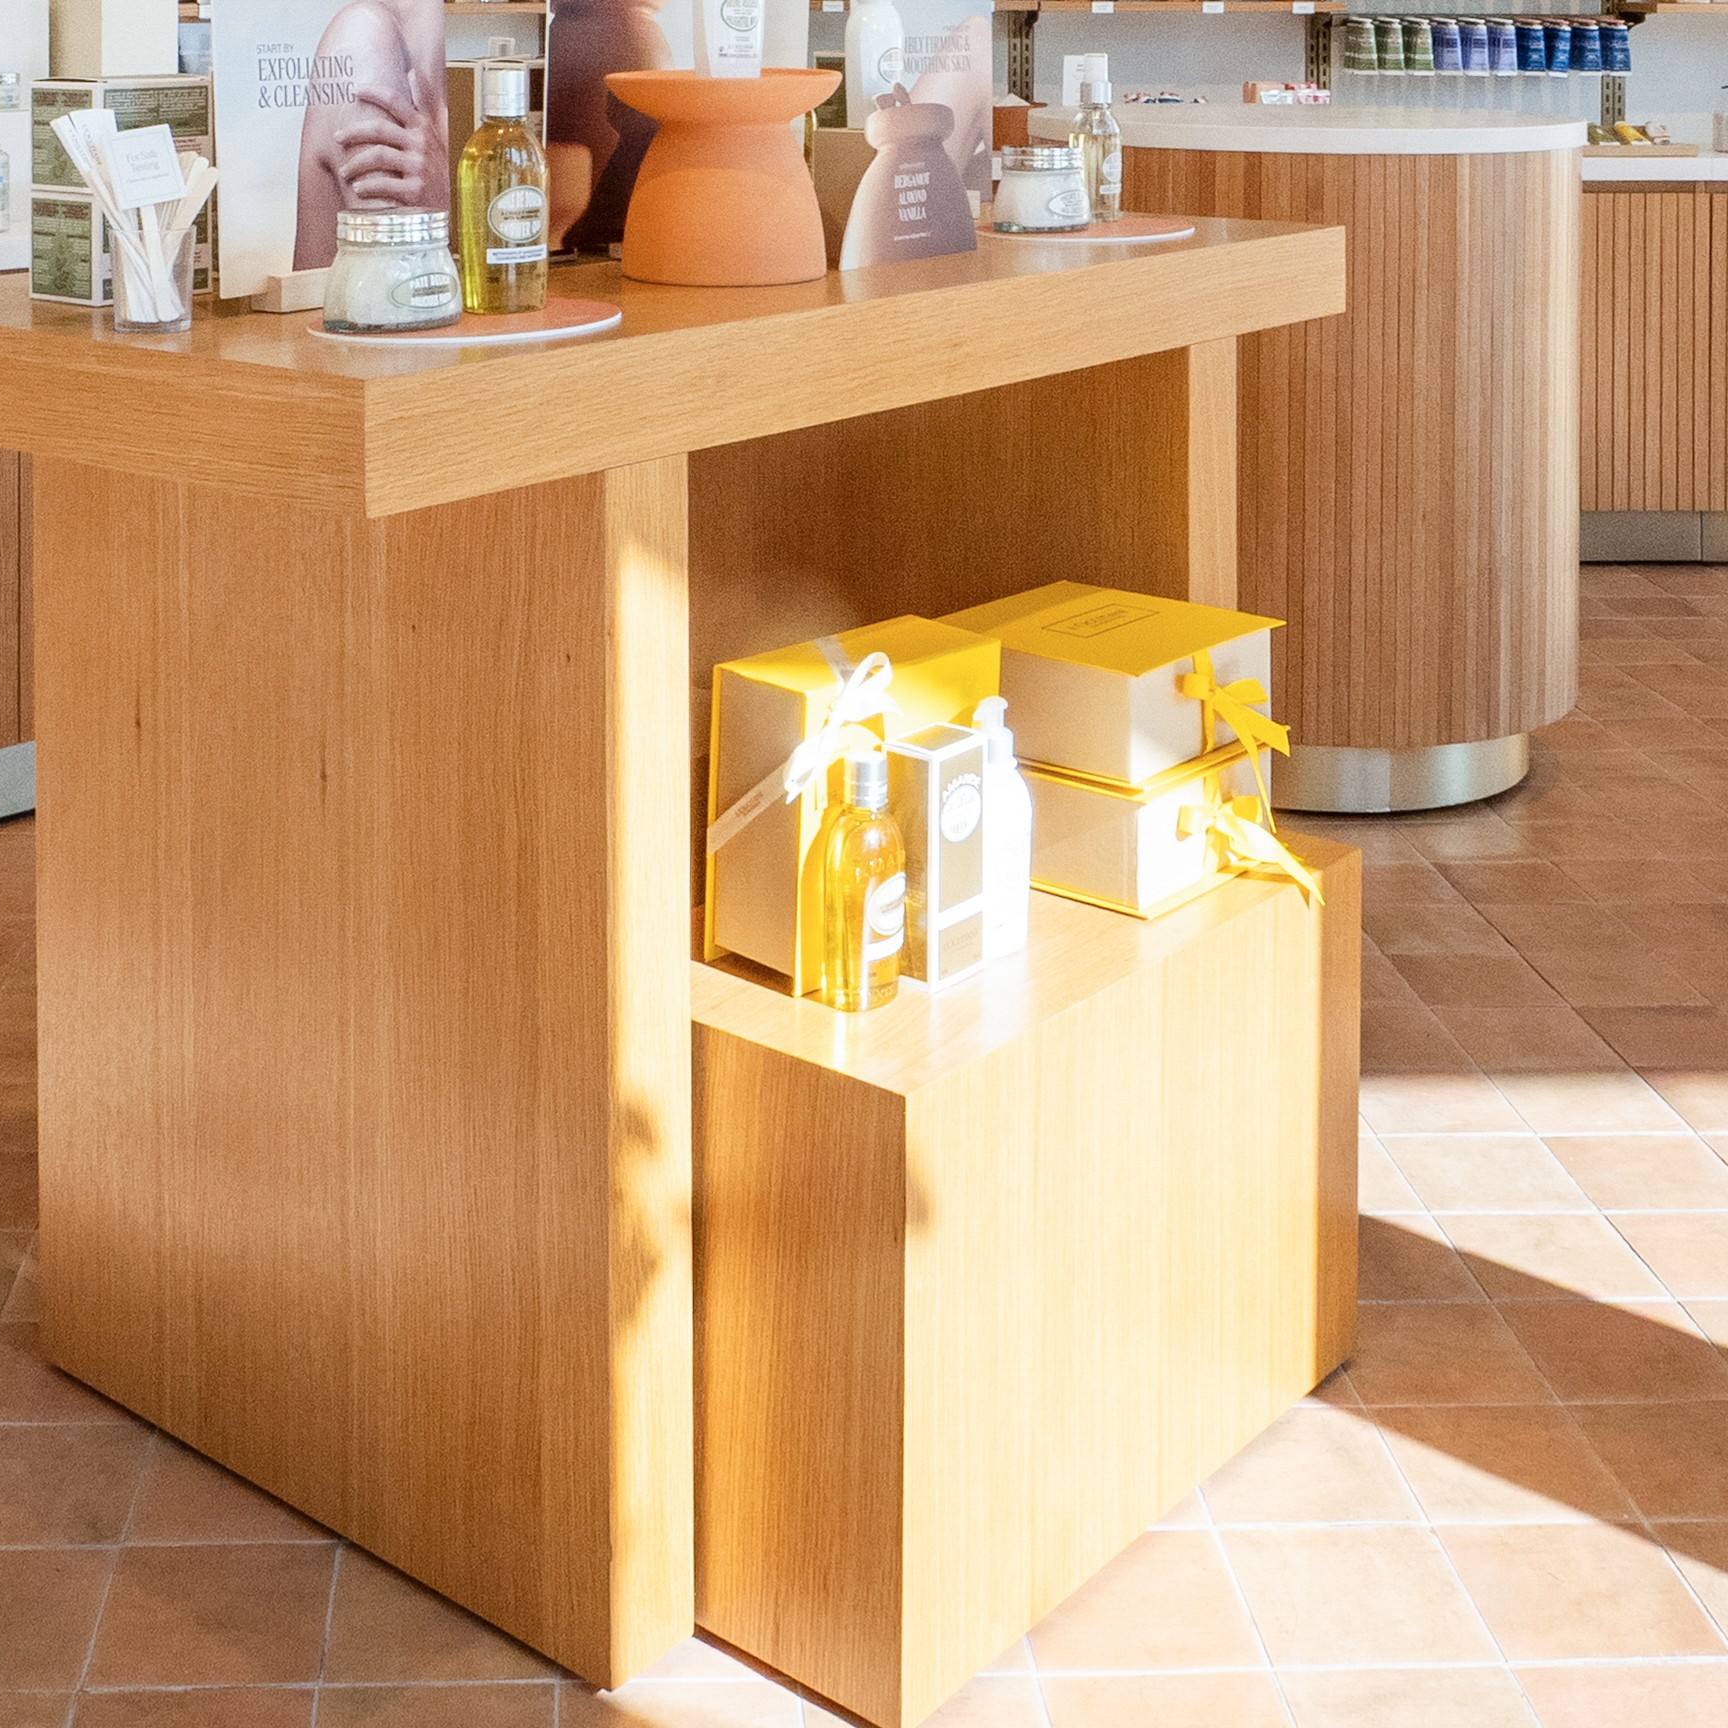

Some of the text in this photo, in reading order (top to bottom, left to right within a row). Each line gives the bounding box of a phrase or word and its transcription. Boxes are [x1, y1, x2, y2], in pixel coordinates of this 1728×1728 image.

[256, 44, 295, 55] START BY
[258, 55, 354, 82] EXFOLIATING
[258, 82, 356, 108] & CLEANSING
